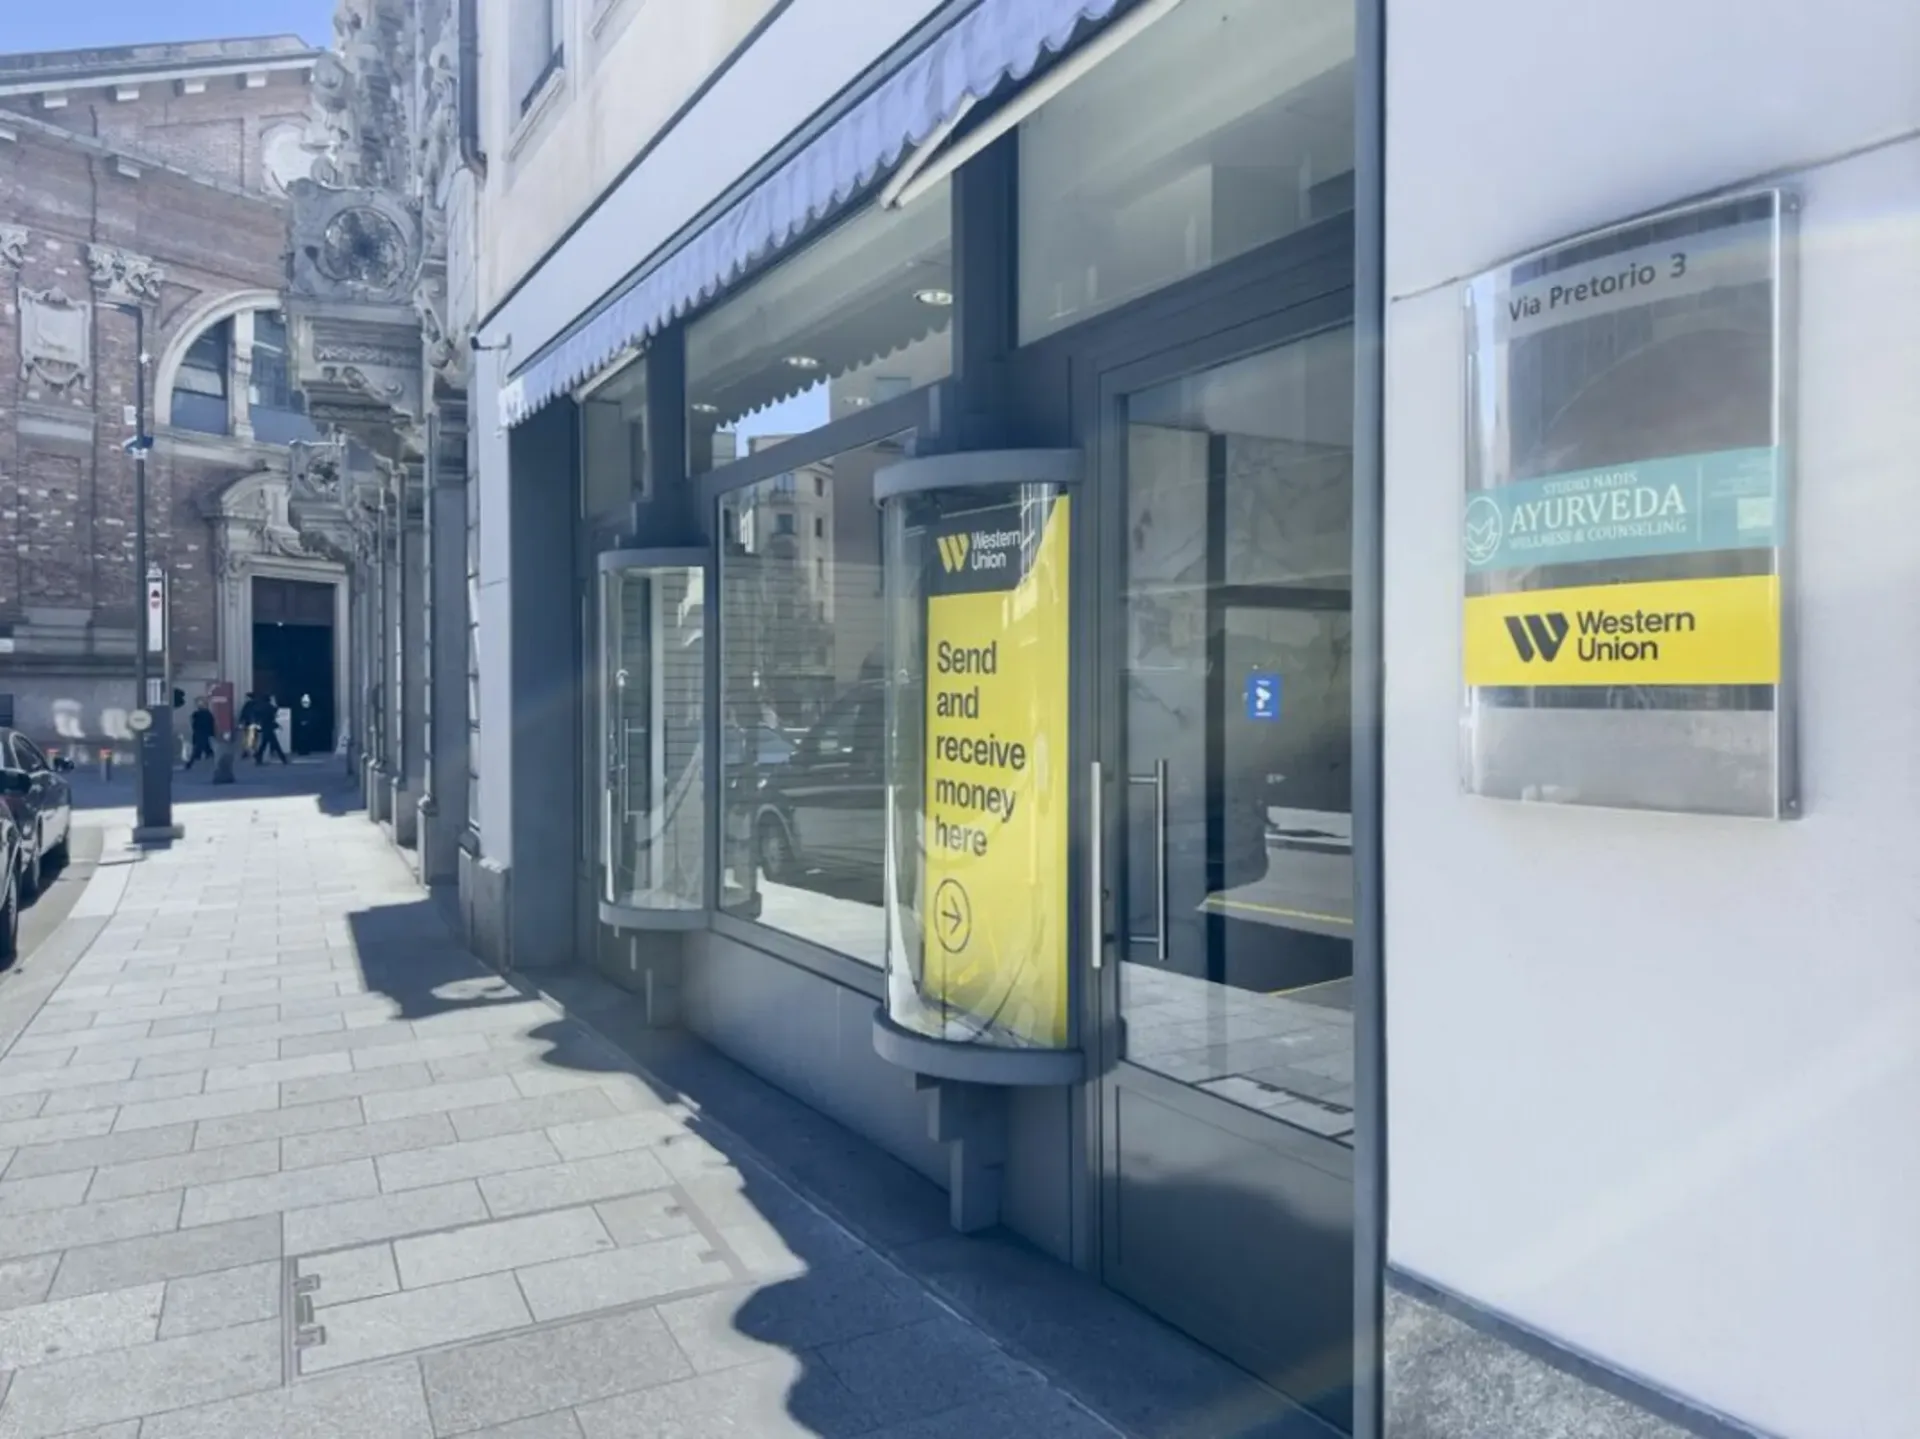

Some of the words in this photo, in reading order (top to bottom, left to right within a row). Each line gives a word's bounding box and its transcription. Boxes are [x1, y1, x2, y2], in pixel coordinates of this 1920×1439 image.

[1508, 297, 1541, 322] Via
[1549, 262, 1656, 311] Pretorio
[1669, 252, 1688, 279] 3
[1508, 483, 1687, 534] AYURVEDA
[970, 530, 1021, 550] Western
[1587, 518, 1688, 542] COUNSELING
[970, 551, 1007, 570] Union
[1576, 609, 1696, 635] Western
[936, 640, 997, 674] Send
[1577, 638, 1659, 663] Union
[936, 686, 979, 719] and
[935, 734, 1026, 771] receive
[935, 778, 1016, 823] money
[934, 815, 988, 857] here
